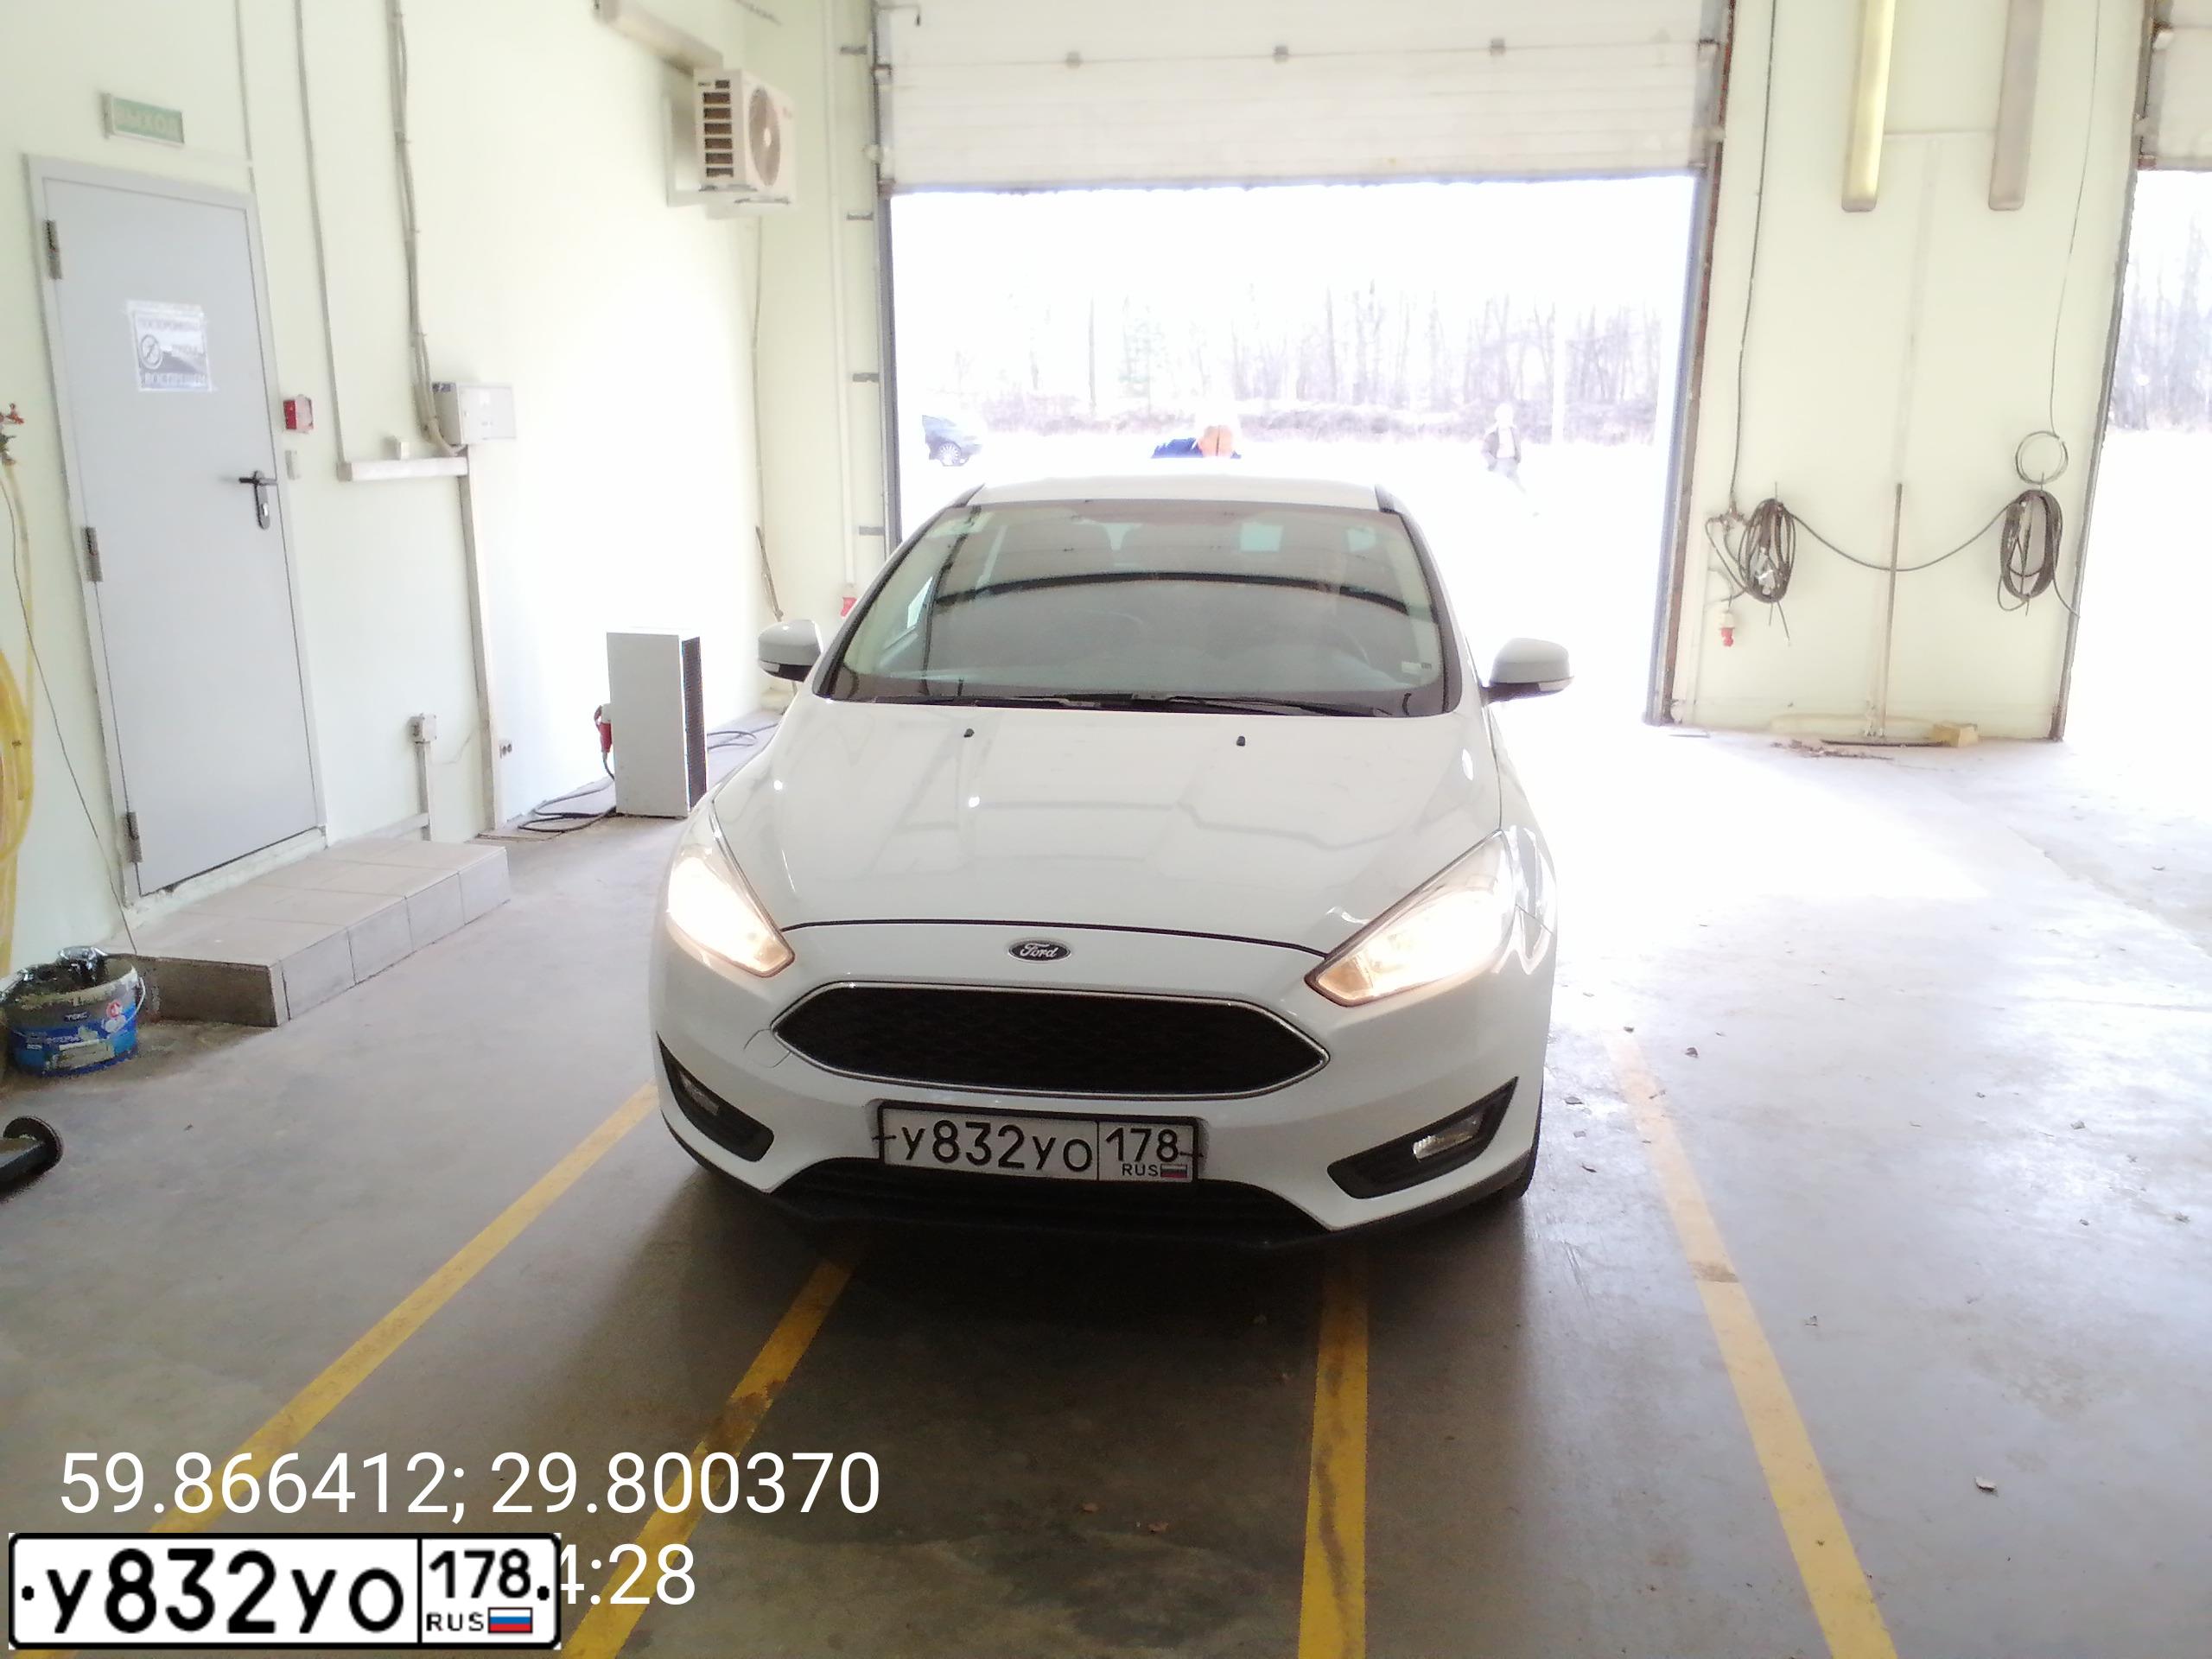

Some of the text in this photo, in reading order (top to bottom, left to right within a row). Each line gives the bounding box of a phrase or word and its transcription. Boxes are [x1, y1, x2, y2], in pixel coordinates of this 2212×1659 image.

[1020, 943, 1058, 957] Ford
[1106, 1127, 1179, 1163] 178
[1122, 1163, 1160, 1177] RUS
